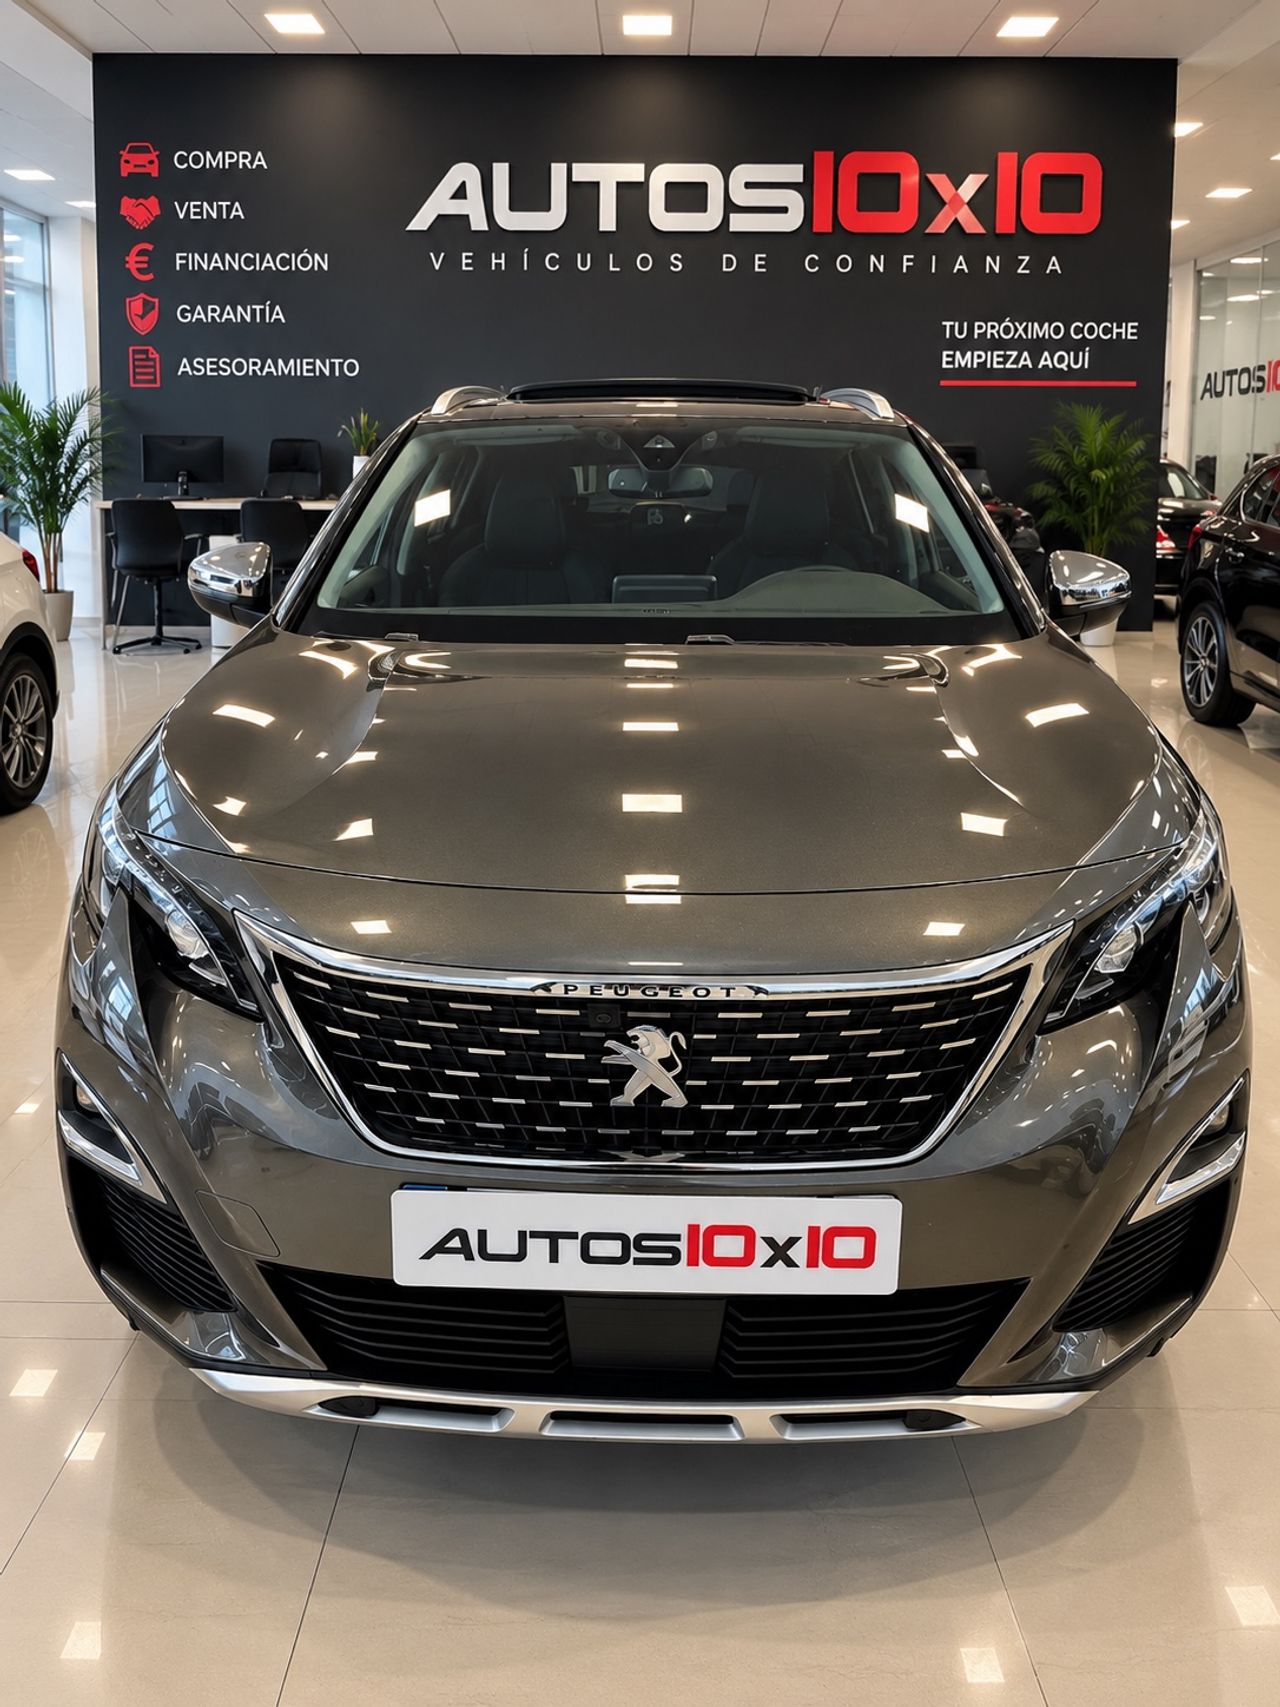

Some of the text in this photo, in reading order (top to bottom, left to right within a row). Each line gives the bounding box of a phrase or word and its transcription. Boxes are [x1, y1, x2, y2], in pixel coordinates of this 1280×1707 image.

[173, 150, 268, 170] COMPRA
[174, 201, 245, 220] VENTA
[175, 248, 329, 272] FINANCIACIÓN
[429, 247, 1062, 274] VEHÍCULOS DE CONFIANZA
[176, 300, 286, 324] GARANTÍA
[941, 316, 1139, 340] TU PRÓXIMO COCHE
[177, 357, 360, 377] ASESORAMIENTO
[941, 346, 1090, 371] EMPIEZA AQUÍ
[563, 984, 736, 998] PEUGEOT
